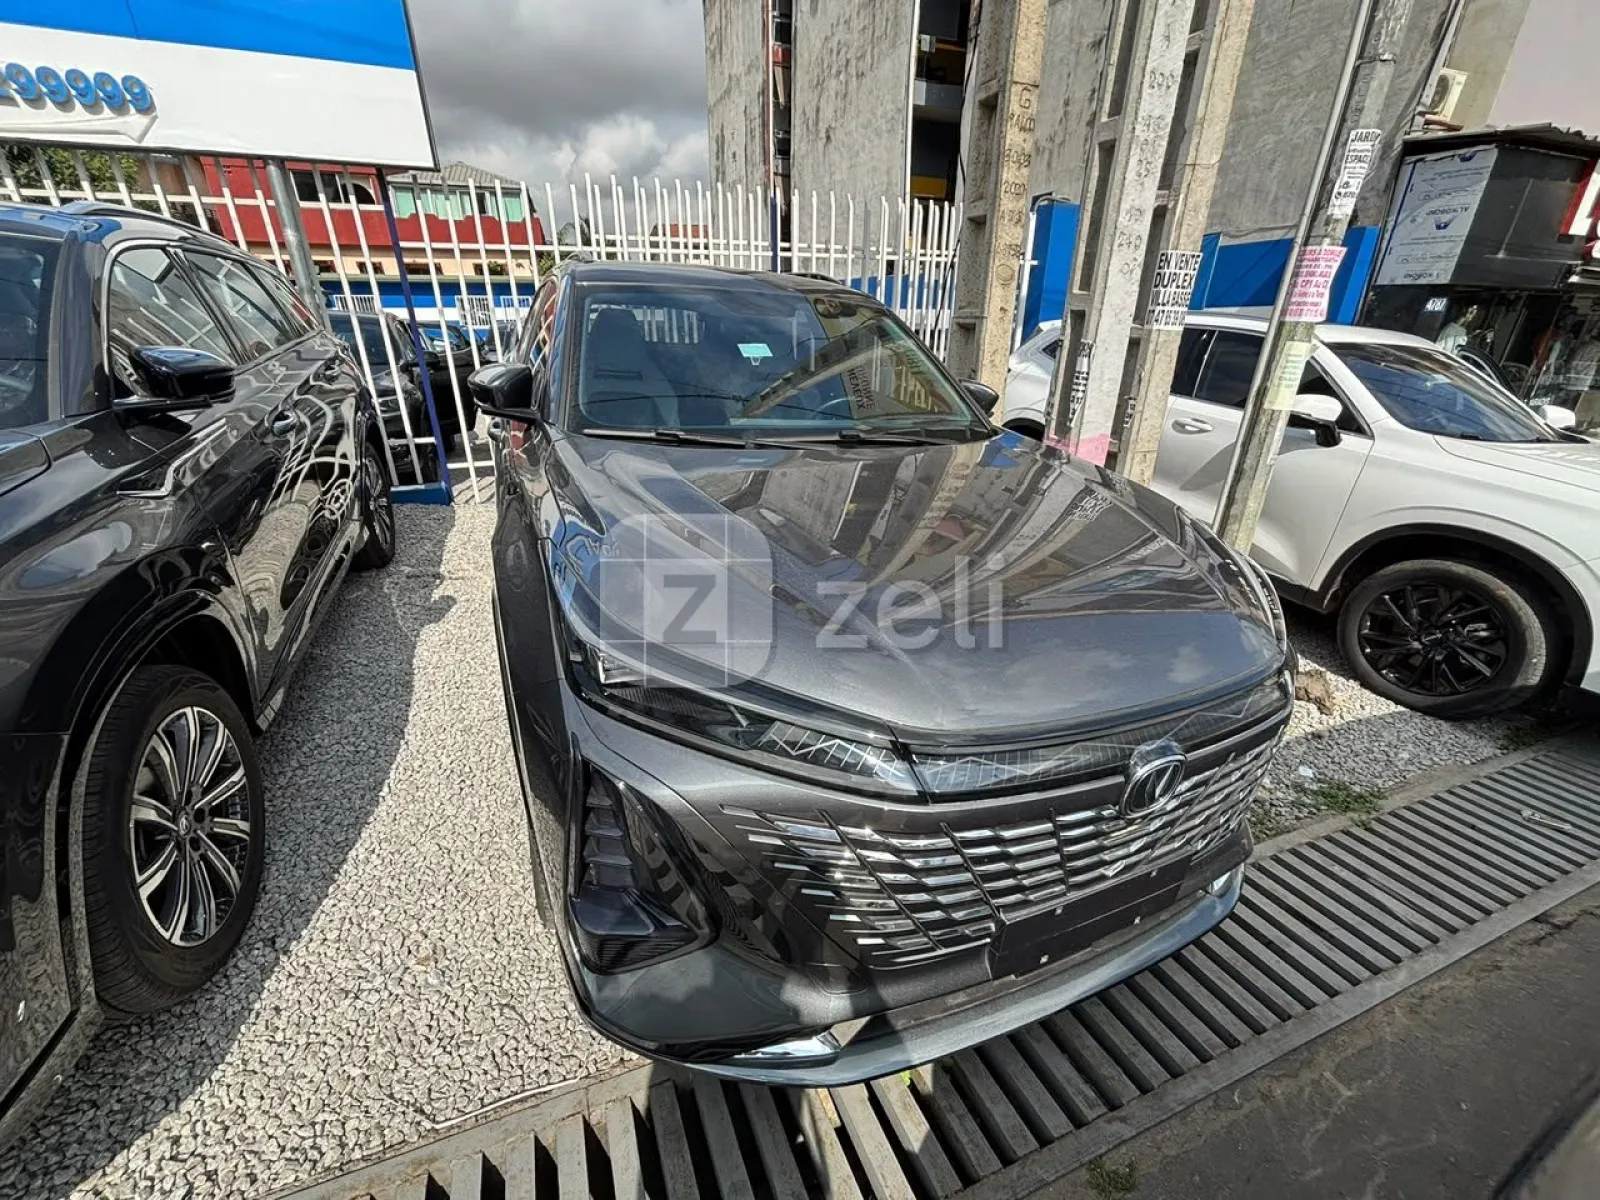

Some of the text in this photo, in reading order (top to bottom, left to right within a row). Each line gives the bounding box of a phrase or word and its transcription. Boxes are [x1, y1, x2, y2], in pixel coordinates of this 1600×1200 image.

[1158, 252, 1173, 271] EN
[1174, 252, 1201, 271] VENTE
[1153, 271, 1196, 289] DUPLEX
